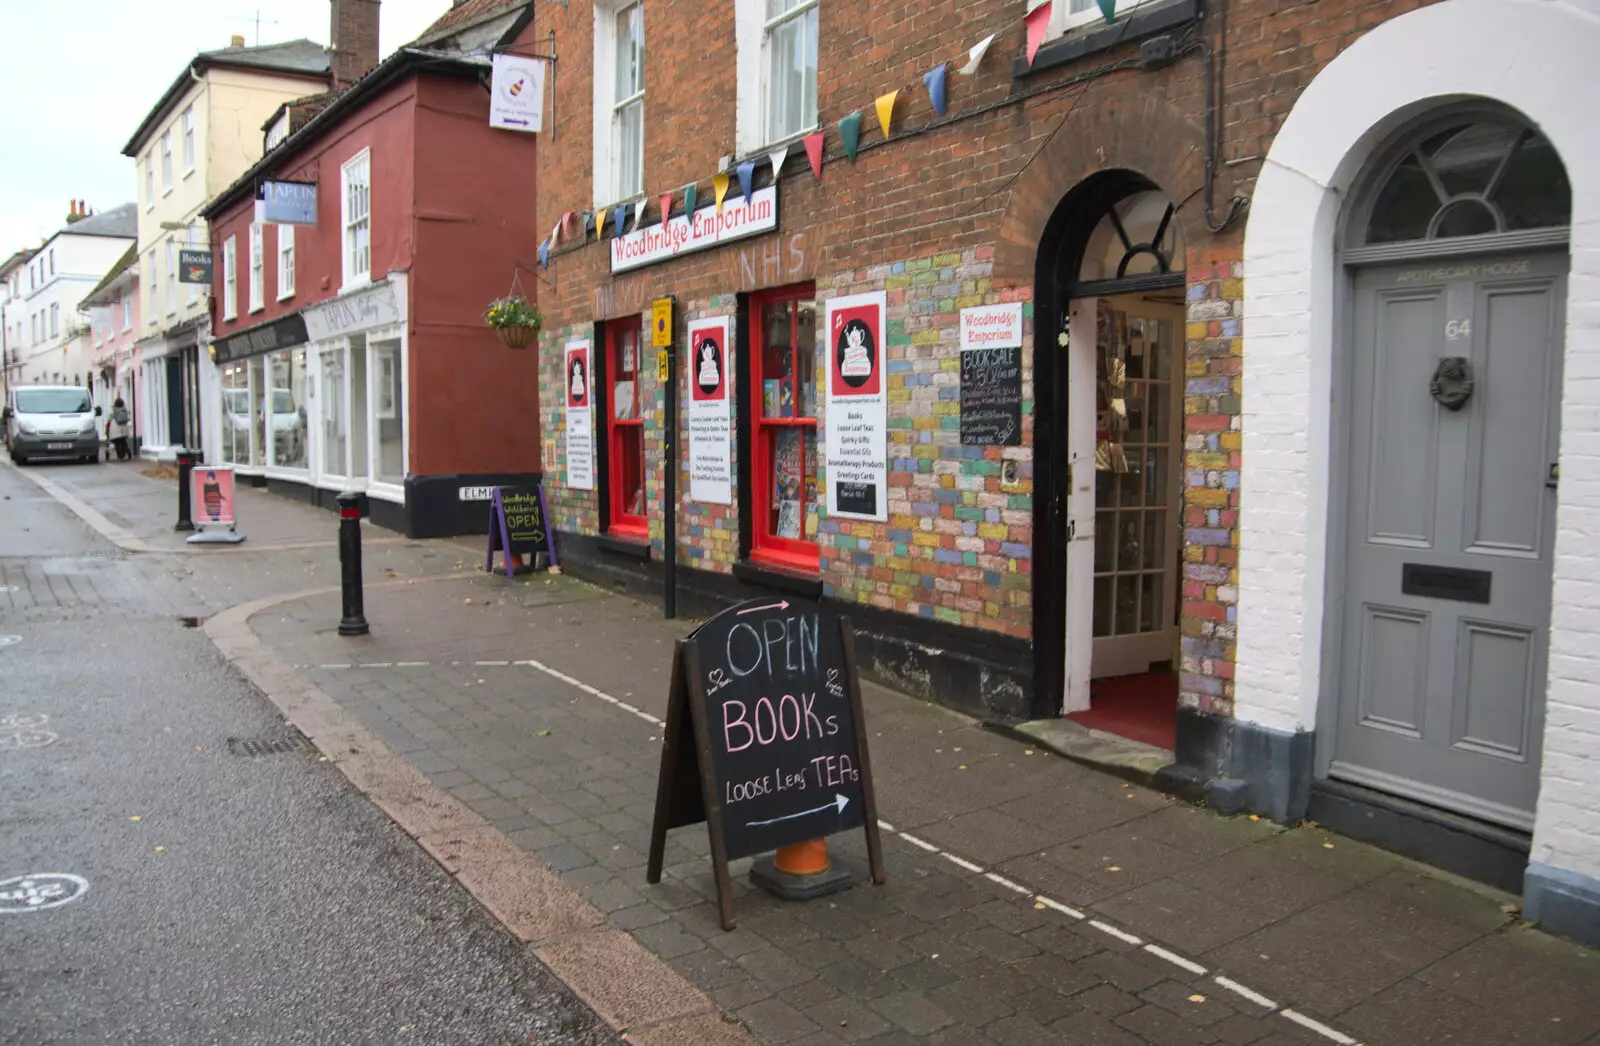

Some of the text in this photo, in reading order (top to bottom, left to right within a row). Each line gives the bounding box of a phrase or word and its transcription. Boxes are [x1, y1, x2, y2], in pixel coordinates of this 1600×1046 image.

[614, 198, 771, 261] Woodbridge Emporium
[182, 252, 212, 265] Books
[740, 233, 805, 290] NHS
[1397, 260, 1529, 282] APOTHECARY HOUSE
[965, 311, 1016, 327] Woodbridge
[968, 329, 1012, 344] Emporium
[1445, 319, 1471, 340] 64
[963, 347, 1014, 370] BOOK SALE
[847, 412, 863, 420] Books
[837, 424, 874, 432] Loose Leaf Teas
[841, 437, 857, 445] Quirky
[862, 448, 872, 456] Oils
[828, 460, 861, 468] Aromatherapy
[862, 460, 885, 469] Products
[836, 471, 875, 480] Greetings Cards
[507, 515, 539, 528] OPEN
[727, 614, 819, 677] OPEN
[726, 775, 772, 804] LOOSE
